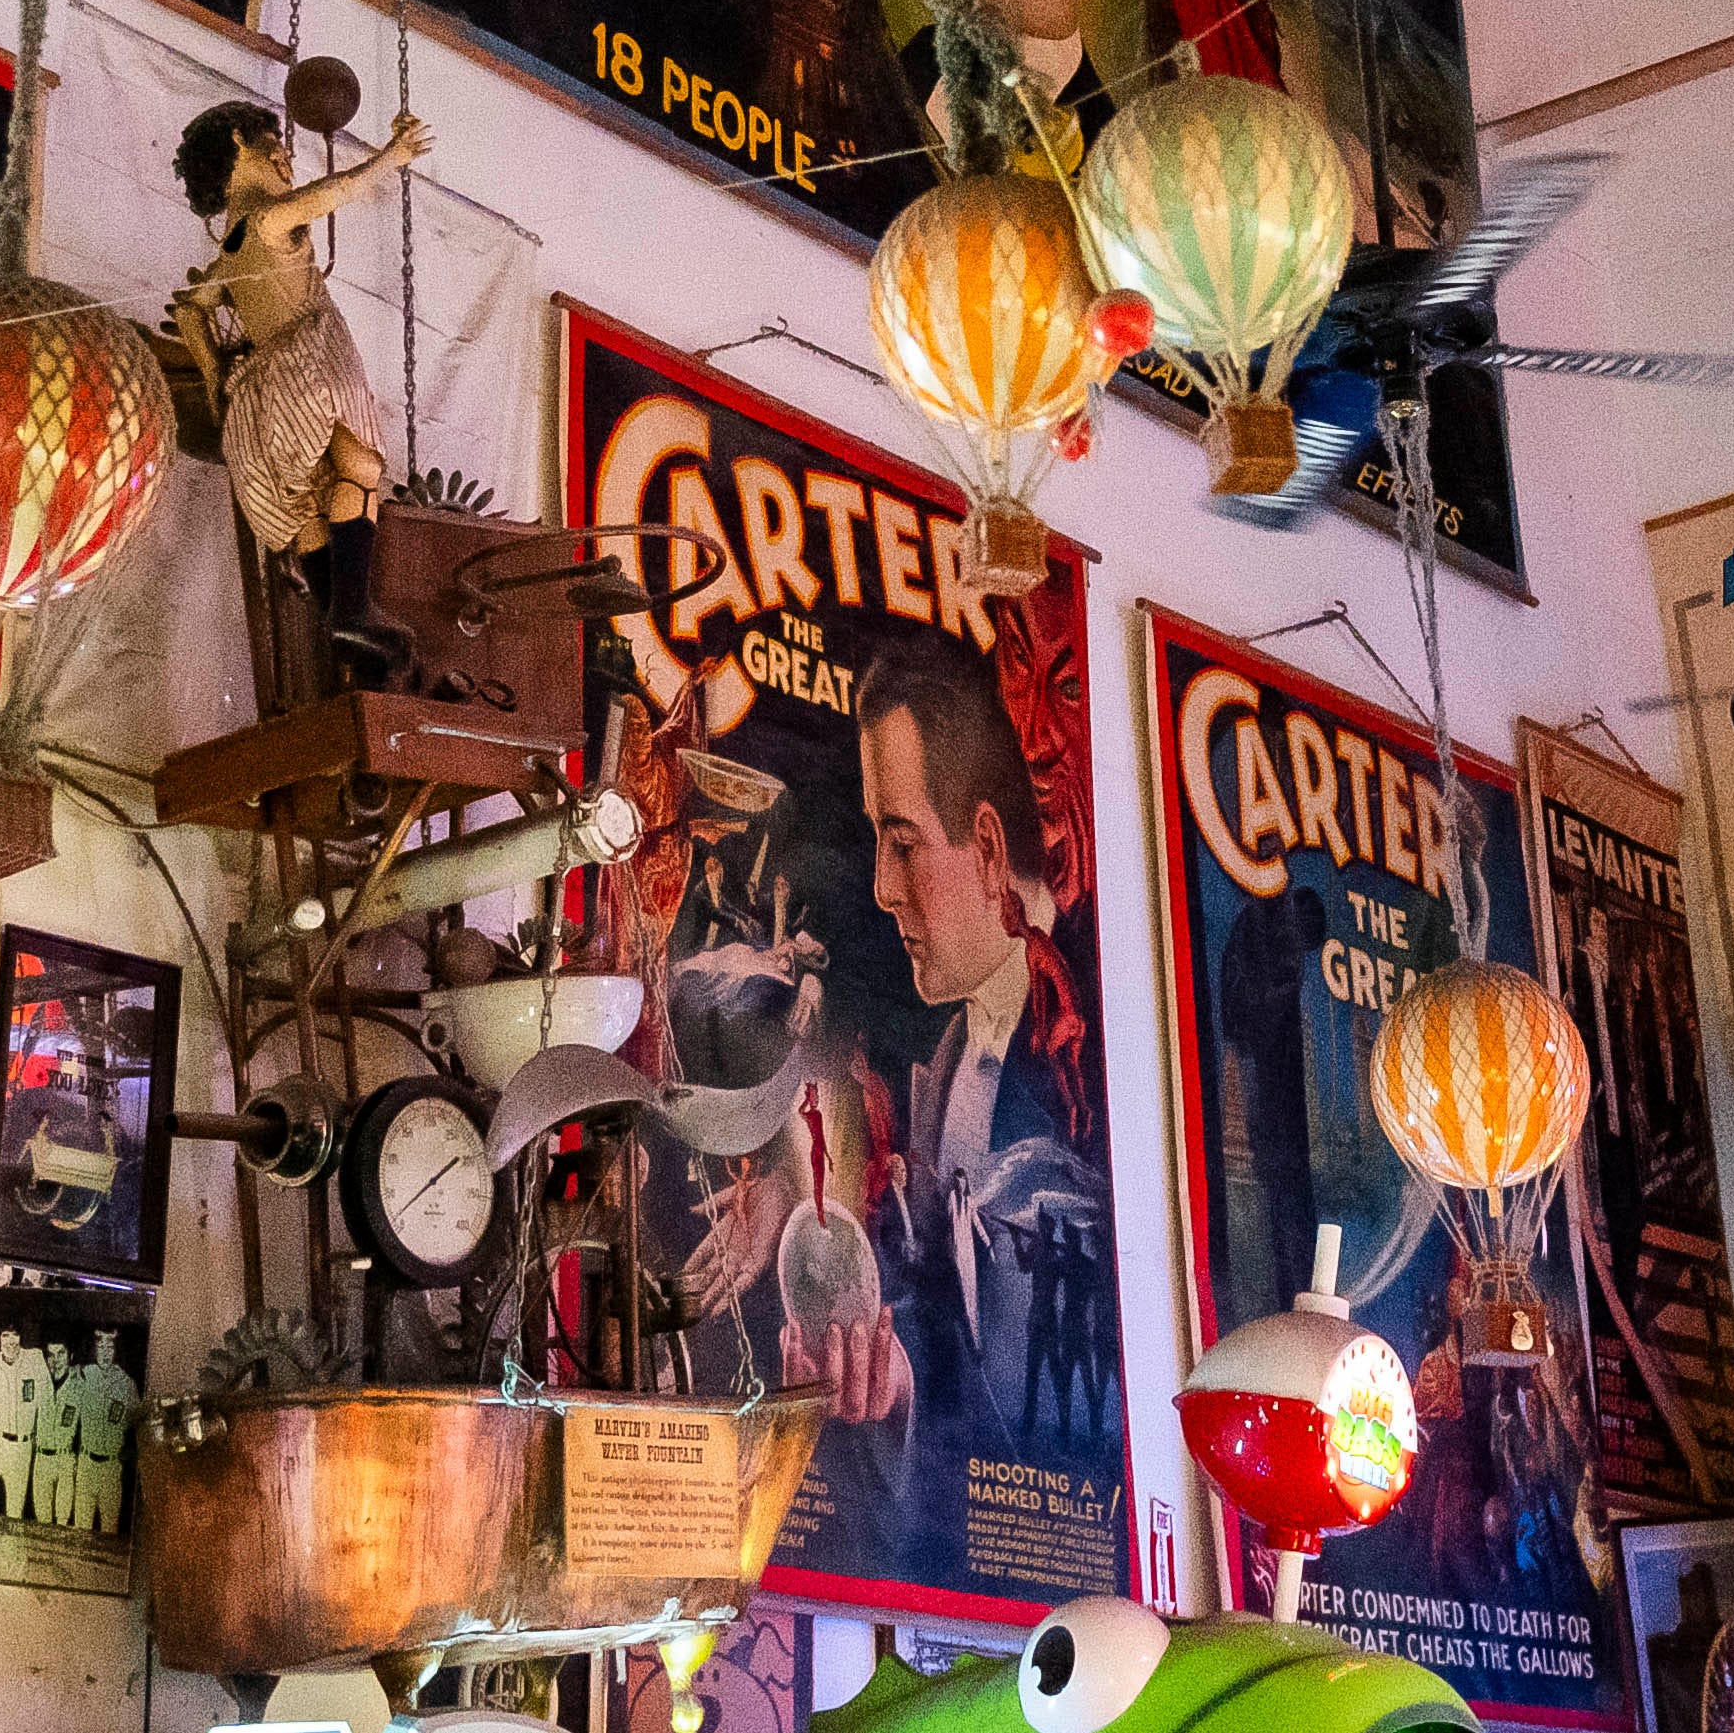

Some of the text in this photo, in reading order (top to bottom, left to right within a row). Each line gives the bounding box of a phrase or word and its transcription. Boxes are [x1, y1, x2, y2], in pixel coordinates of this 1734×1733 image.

[592, 23, 816, 193] 18 PEOPLE
[595, 392, 997, 736] CARTER
[780, 612, 824, 652] THE
[742, 631, 854, 716] GREAT
[1347, 890, 1410, 950] THE
[601, 1442, 703, 1464] WATER FOUNTAIN
[968, 1457, 1095, 1498] SHOOTING A
[968, 1481, 1041, 1510] MARKED
[1352, 1588, 1464, 1630] CONDEMNED
[1470, 1602, 1491, 1632] TO
[1496, 1606, 1552, 1640] DEATH
[1558, 1615, 1592, 1645] FOR
[1407, 1633, 1594, 1679] CHEATS THE GALLOWS
